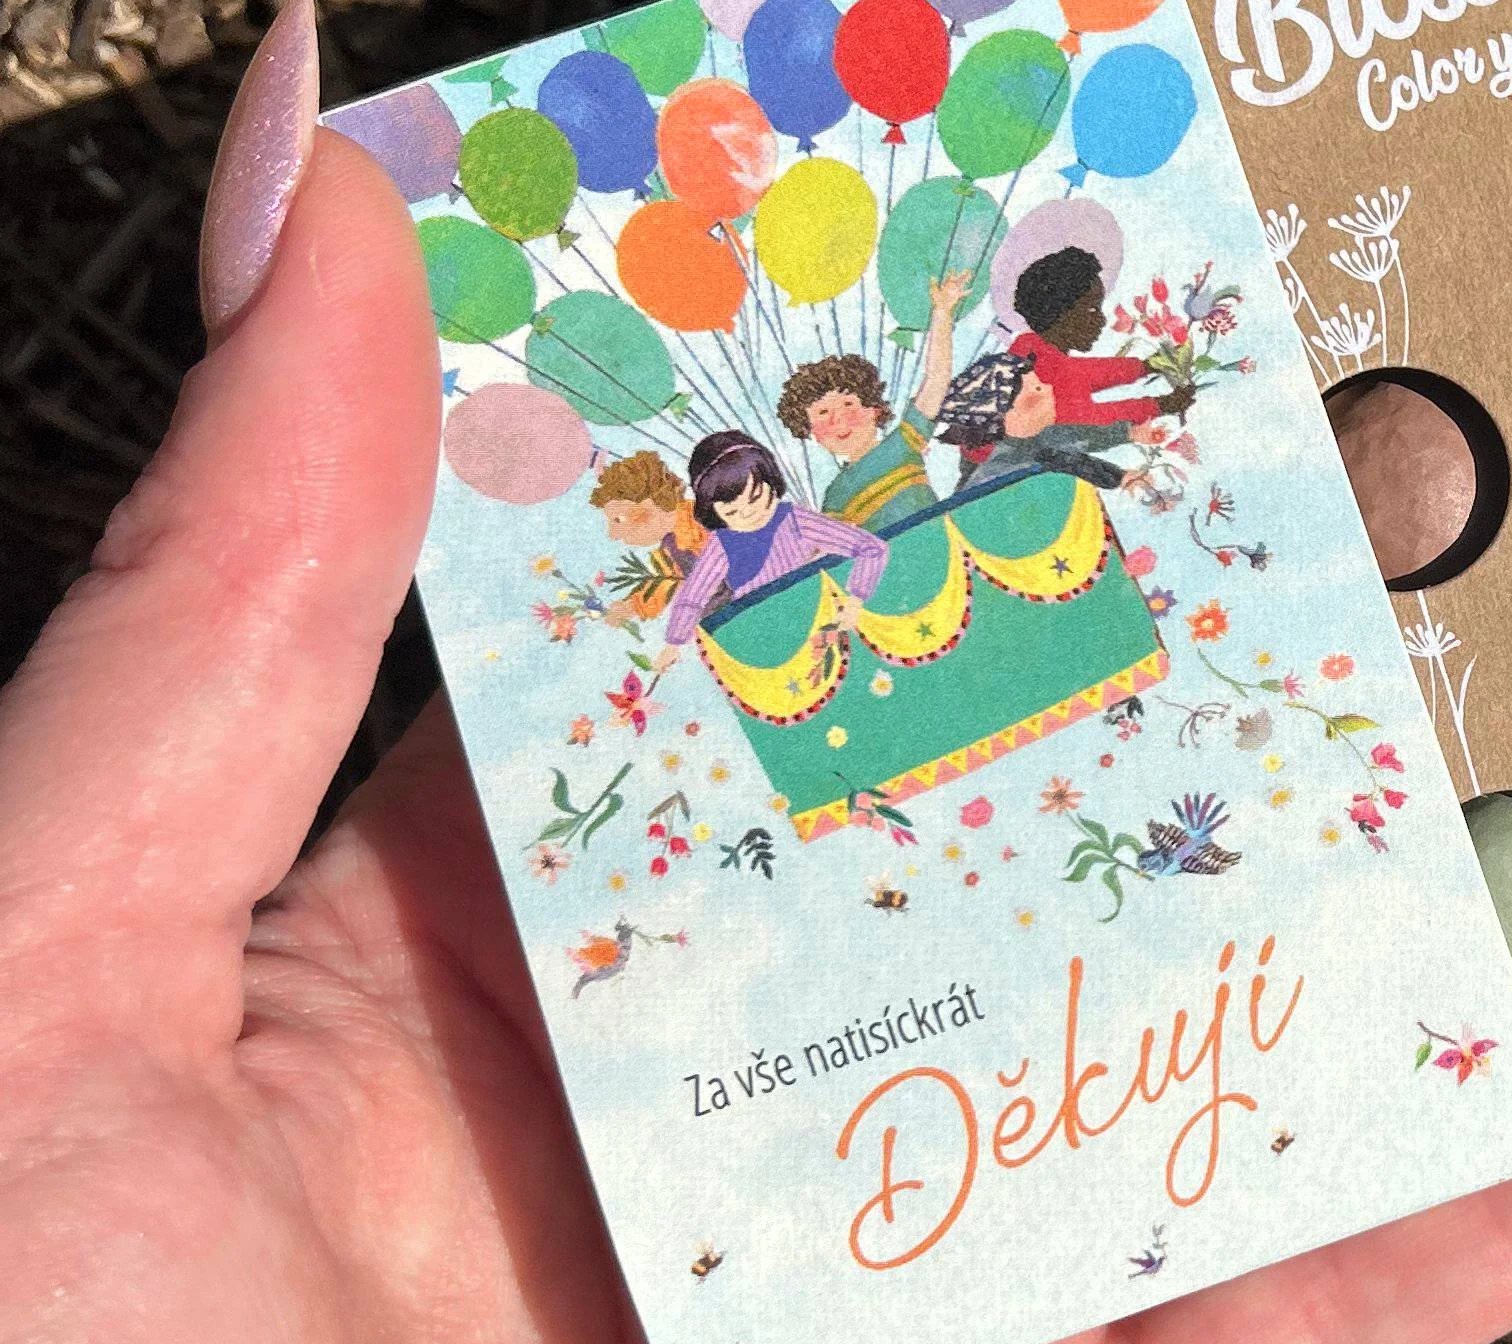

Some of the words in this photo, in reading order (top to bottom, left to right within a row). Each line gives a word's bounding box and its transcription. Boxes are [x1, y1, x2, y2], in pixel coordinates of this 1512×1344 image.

[1356, 47, 1485, 132] Color
[684, 1074, 731, 1116] Za
[734, 1048, 797, 1098] vše
[803, 982, 985, 1077] natisíckrát
[836, 935, 1304, 1271] Děkuji
